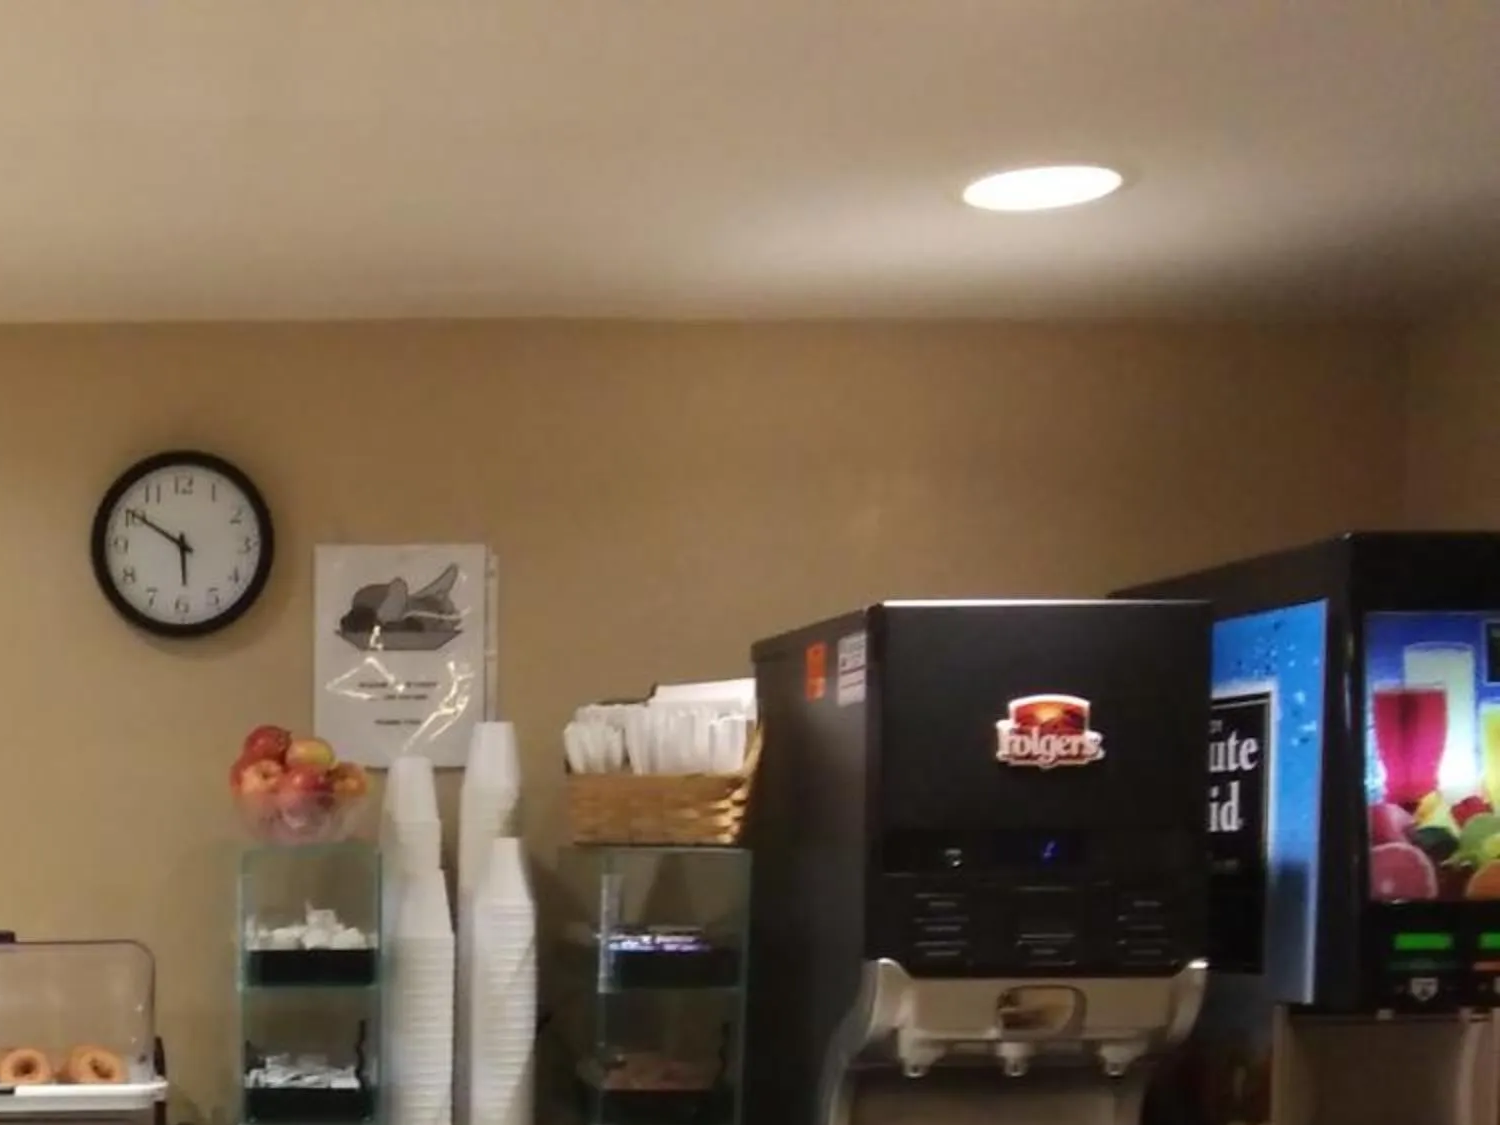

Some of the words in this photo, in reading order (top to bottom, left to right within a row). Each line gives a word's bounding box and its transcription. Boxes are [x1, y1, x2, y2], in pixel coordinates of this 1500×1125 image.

[144, 484, 161, 504] 11
[173, 475, 194, 495] 12
[146, 589, 158, 608] 7
